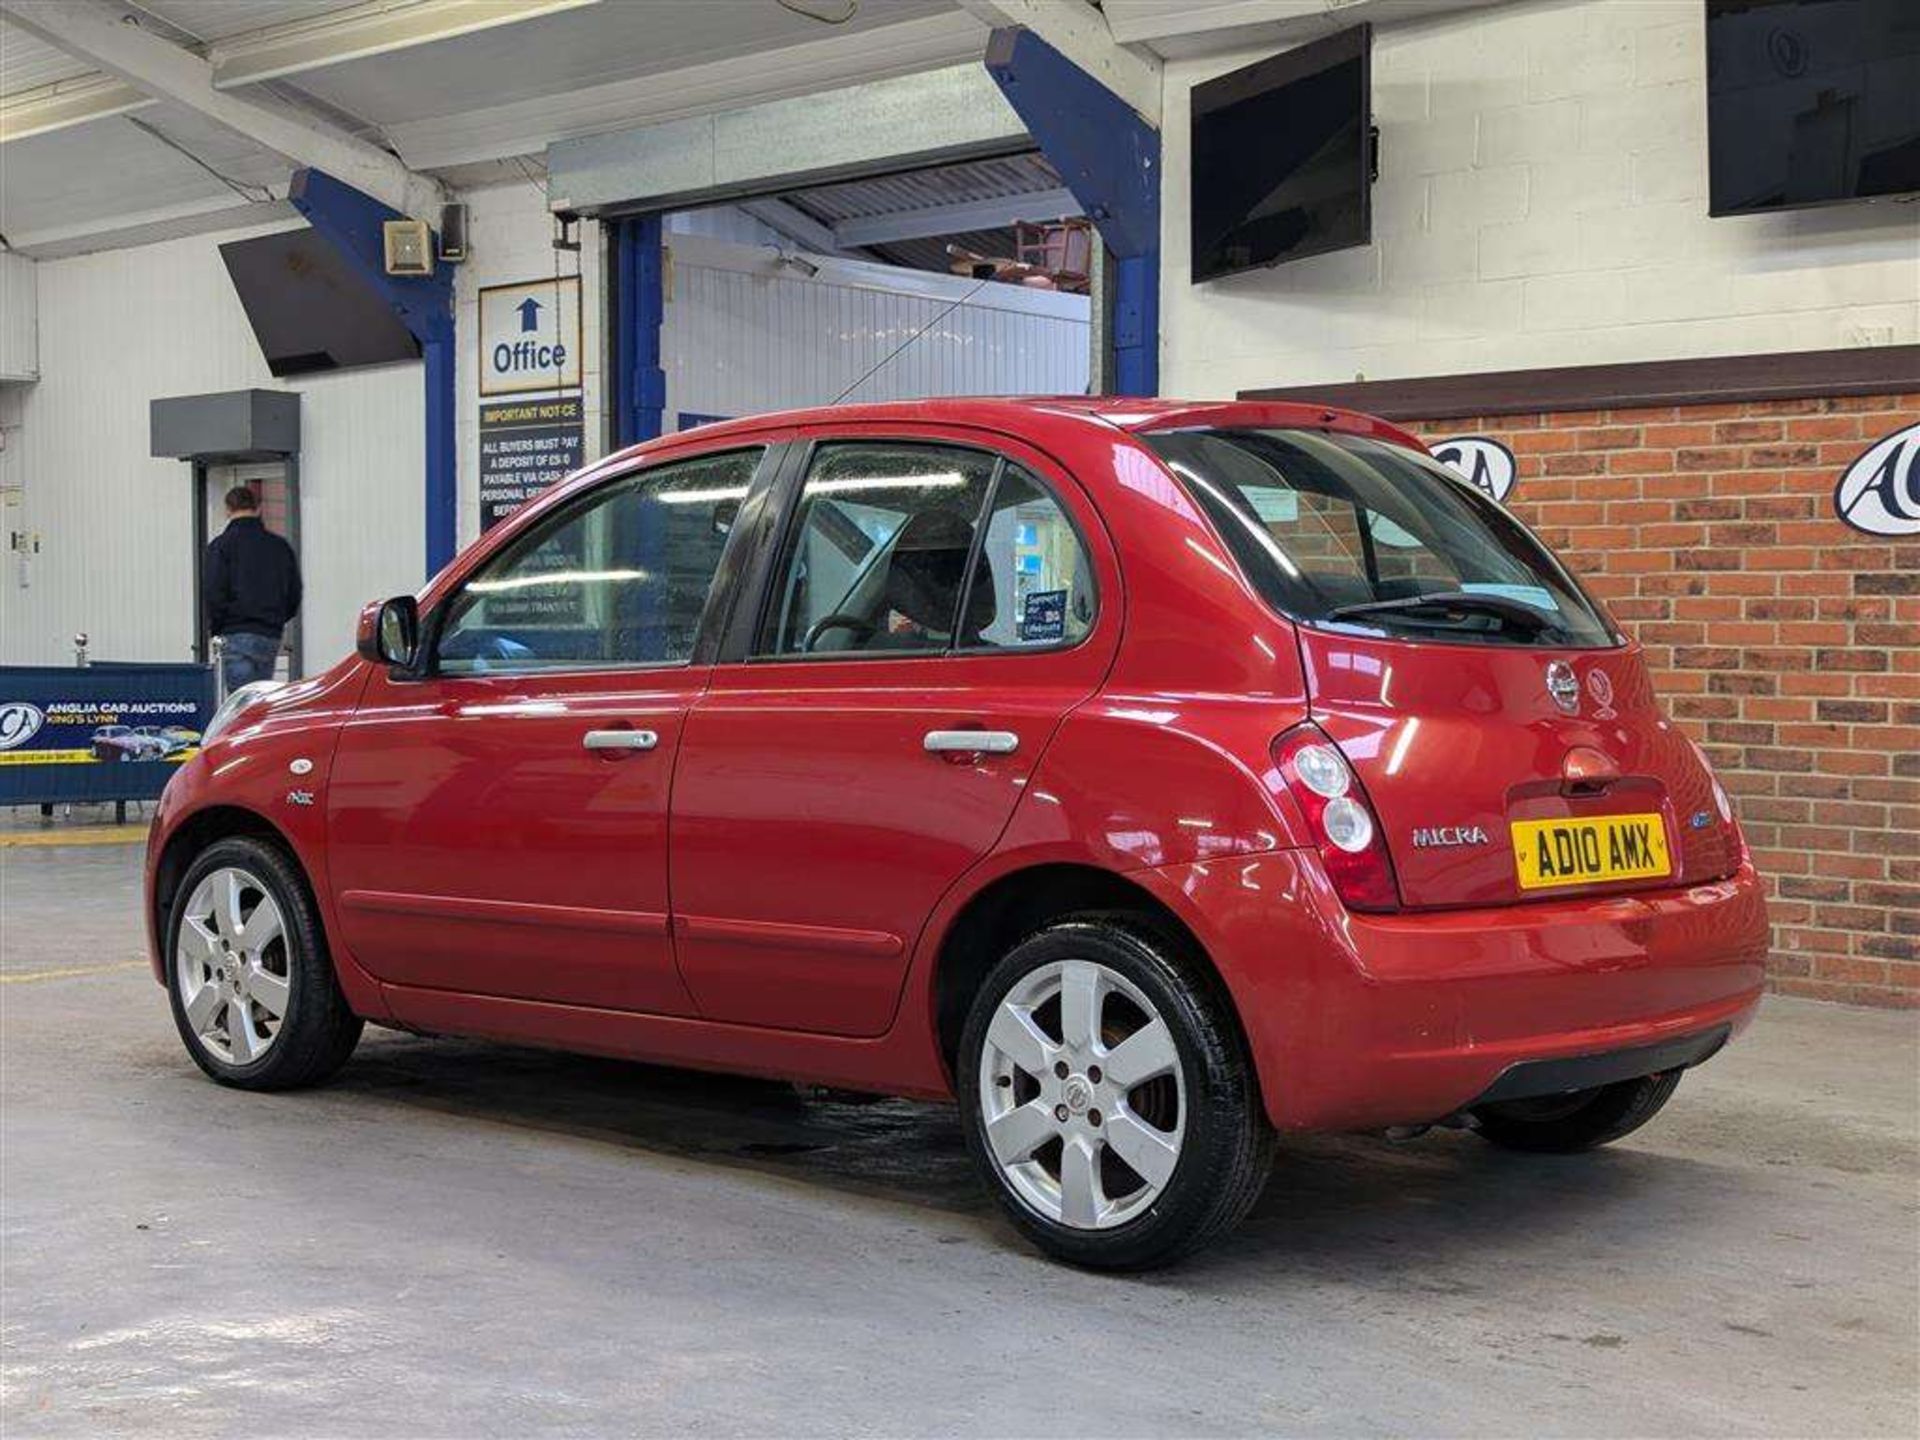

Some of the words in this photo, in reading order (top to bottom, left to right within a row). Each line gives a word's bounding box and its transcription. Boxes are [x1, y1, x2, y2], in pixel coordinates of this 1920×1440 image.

[494, 342, 566, 373] Office
[484, 406, 538, 422] IMPORTANT
[483, 443, 498, 453] ALL
[500, 440, 533, 453] BUYERS
[534, 438, 559, 450] MUST
[491, 457, 498, 468] A
[499, 455, 533, 468] DEPOSIT
[536, 454, 548, 466] OF
[549, 453, 570, 466] £50
[483, 472, 521, 485] PAYABLE
[522, 471, 538, 483] VIA
[481, 486, 525, 500] PERSONAL
[46, 703, 99, 714] ANGLIA
[101, 703, 129, 714] CAR
[130, 702, 197, 714] AUCTIONS
[46, 714, 86, 725] KING'S
[87, 714, 119, 725] LYNN
[1412, 826, 1488, 847] MICRA
[1538, 827, 1602, 878] AD10
[1609, 823, 1656, 871] AMX
